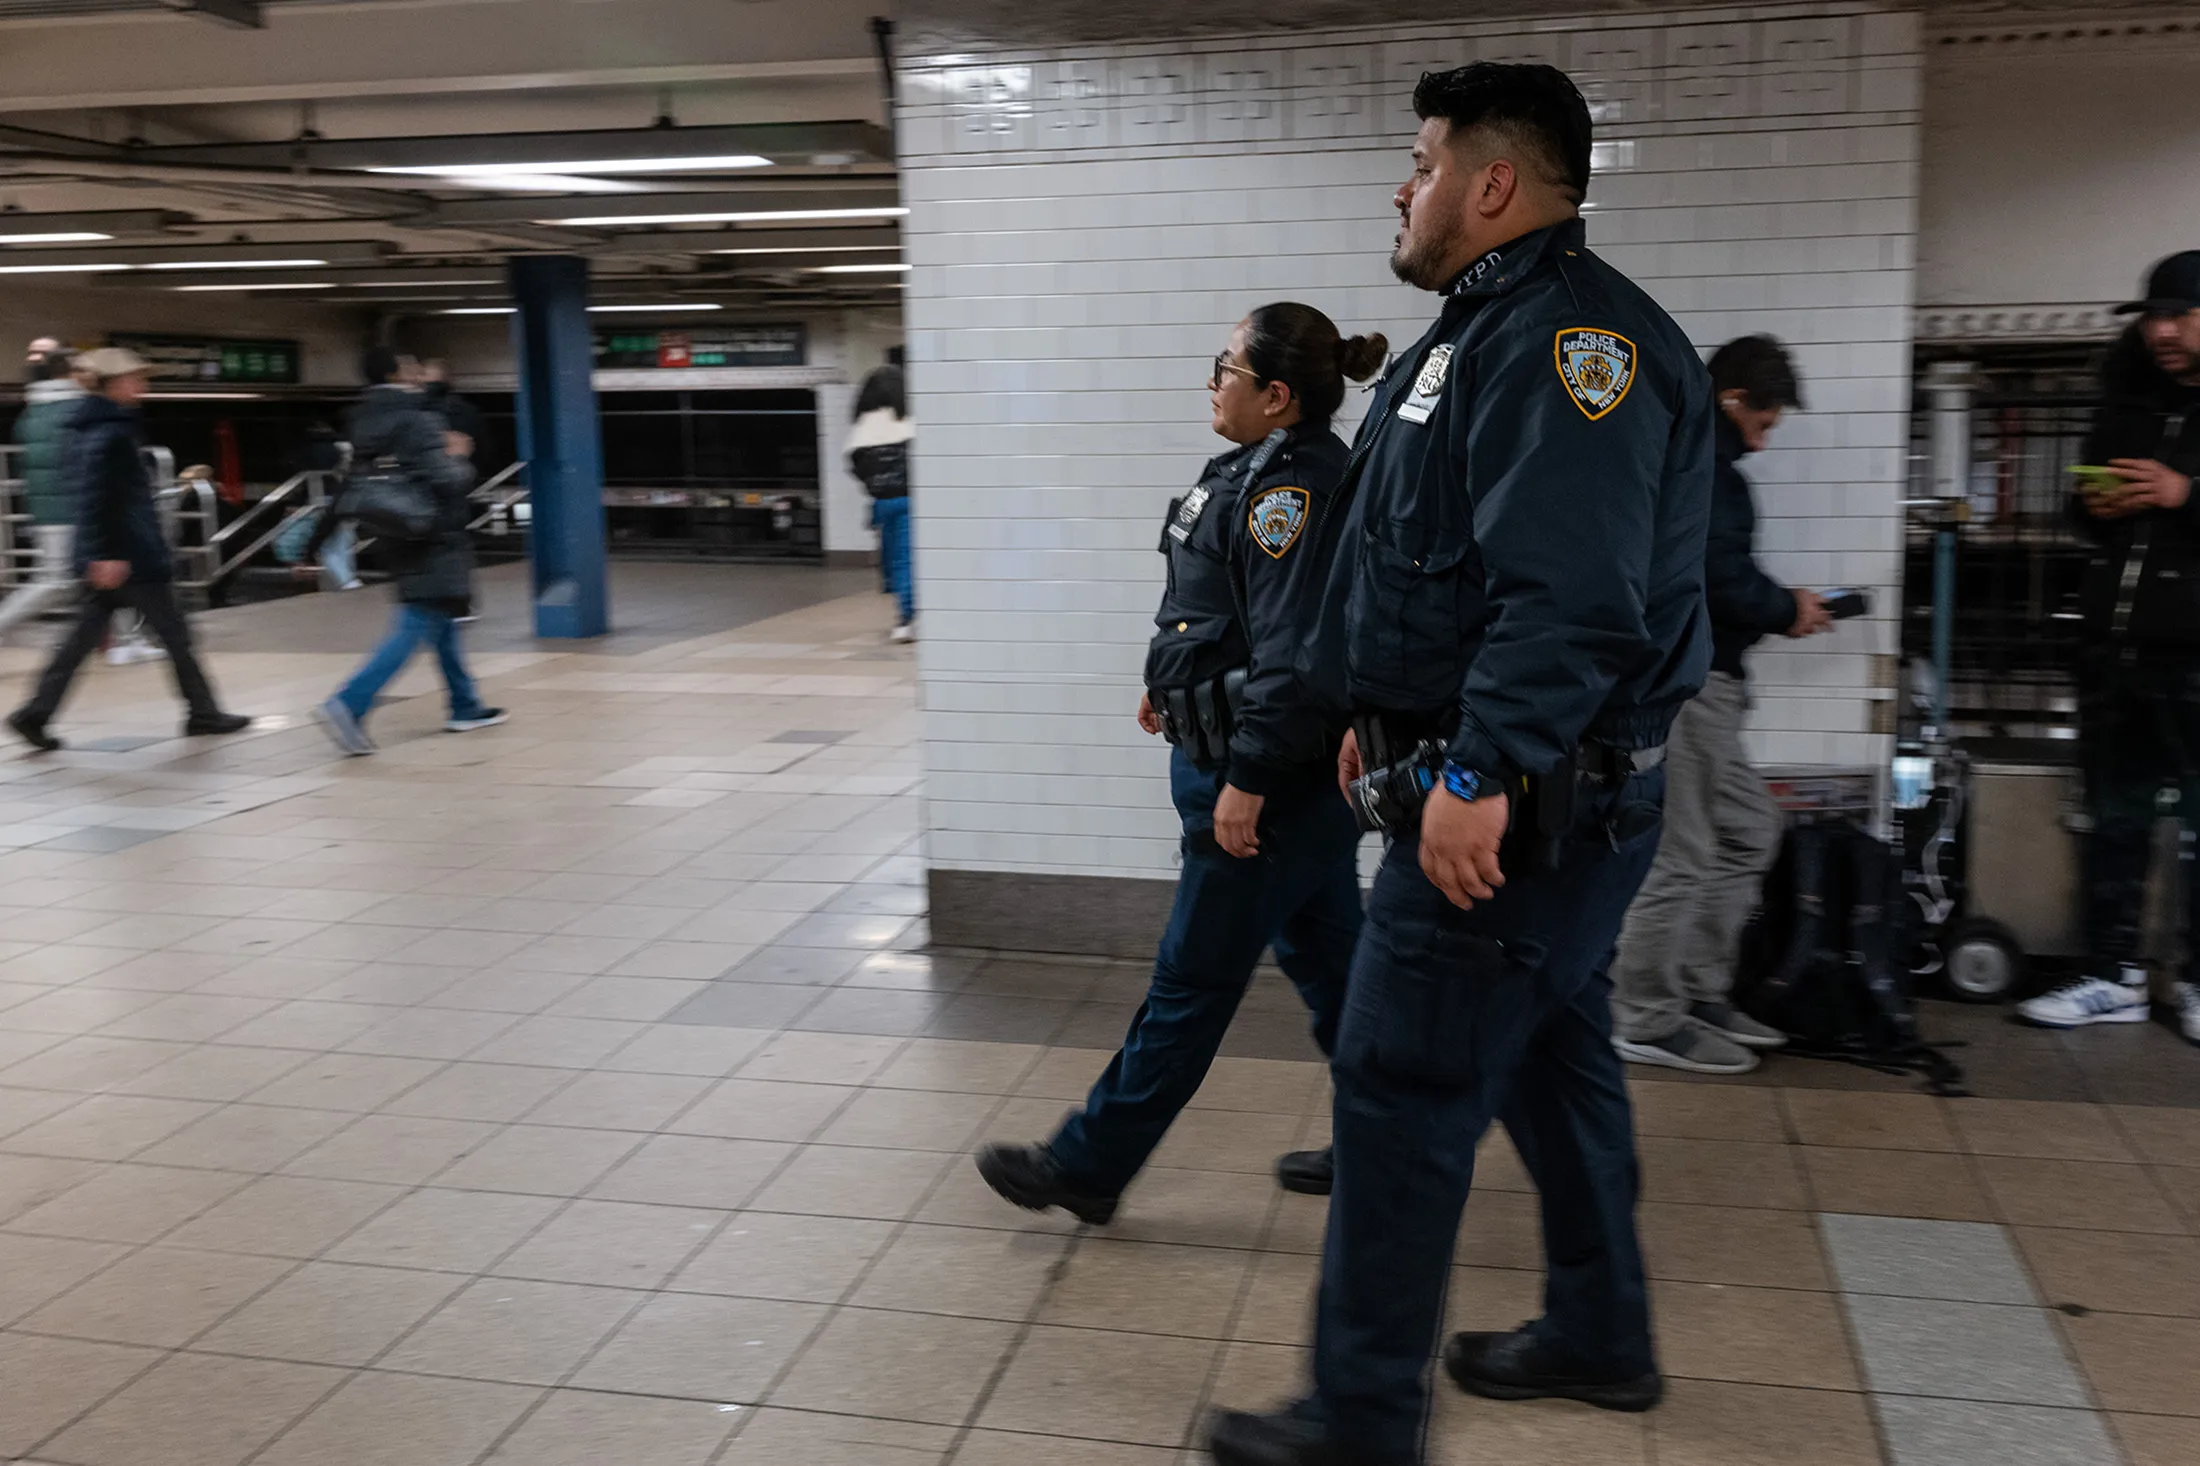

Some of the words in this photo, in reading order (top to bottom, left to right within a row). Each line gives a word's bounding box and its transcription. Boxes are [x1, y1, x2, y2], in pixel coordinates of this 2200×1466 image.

[1578, 332, 1617, 349] POLICE
[1563, 341, 1630, 363] DEPARTMENT
[1562, 362, 1577, 385] CITY
[1573, 386, 1587, 402] OF
[1598, 392, 1616, 410] NEW
[1614, 369, 1630, 392] YORK
